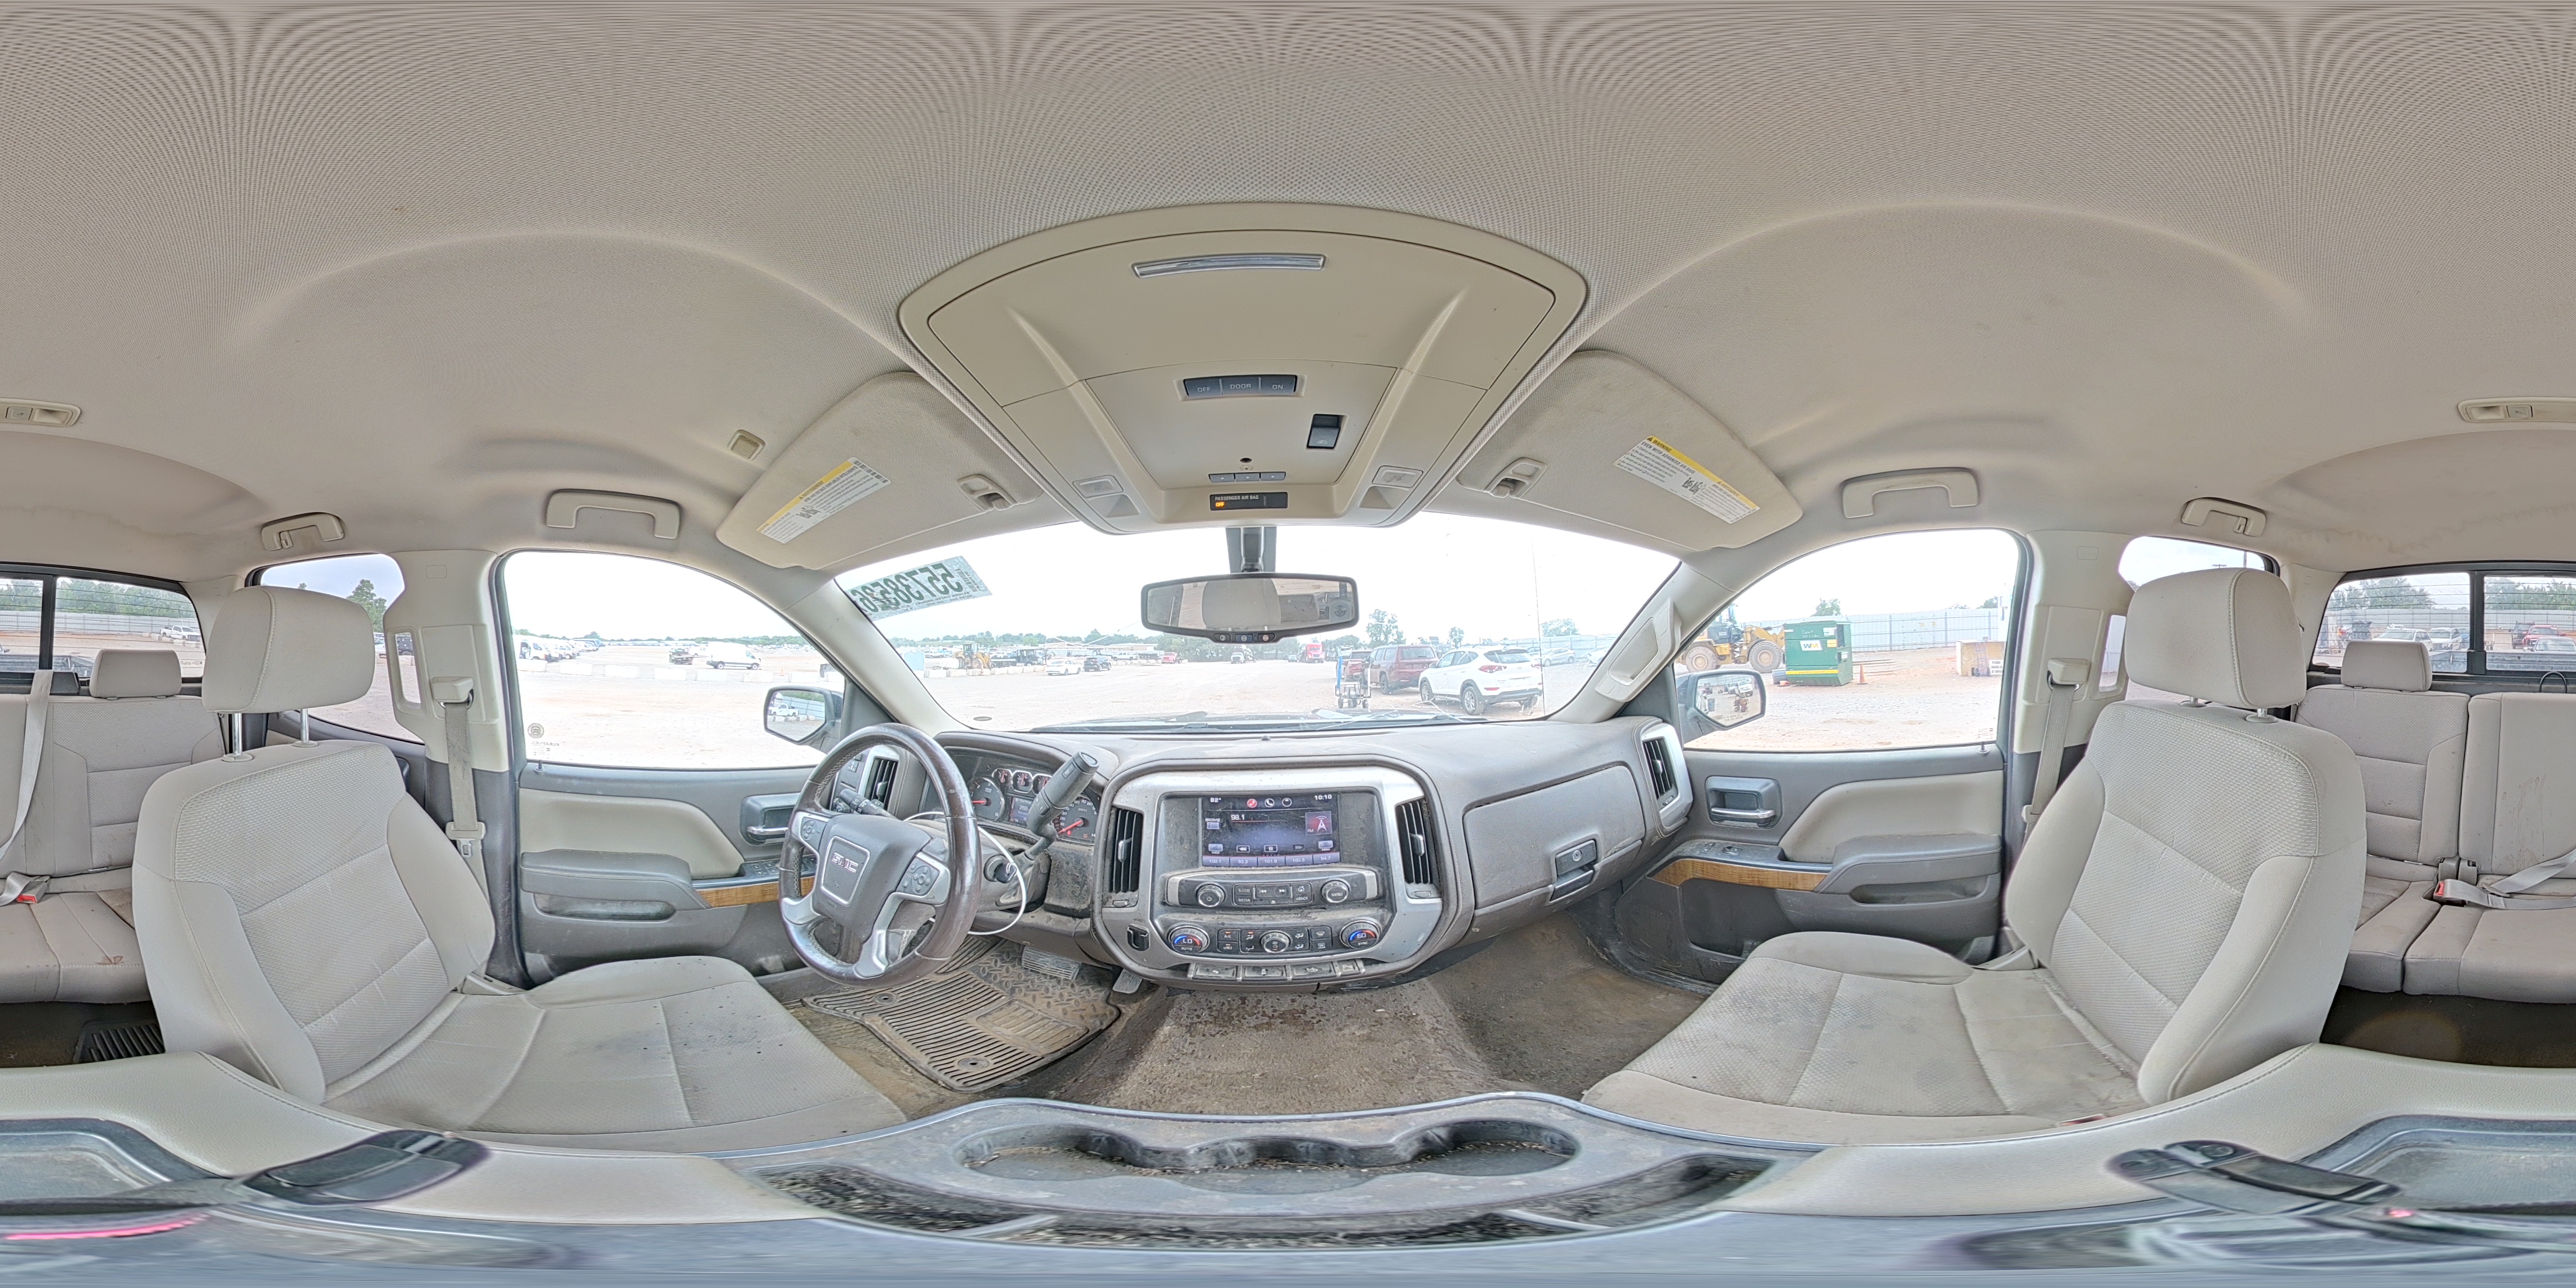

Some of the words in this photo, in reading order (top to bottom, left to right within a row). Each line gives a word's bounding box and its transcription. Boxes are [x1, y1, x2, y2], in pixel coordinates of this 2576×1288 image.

[1652, 439, 1673, 453] WARNING
[1661, 453, 1681, 466] ADVANCED
[830, 852, 859, 873] GMC
